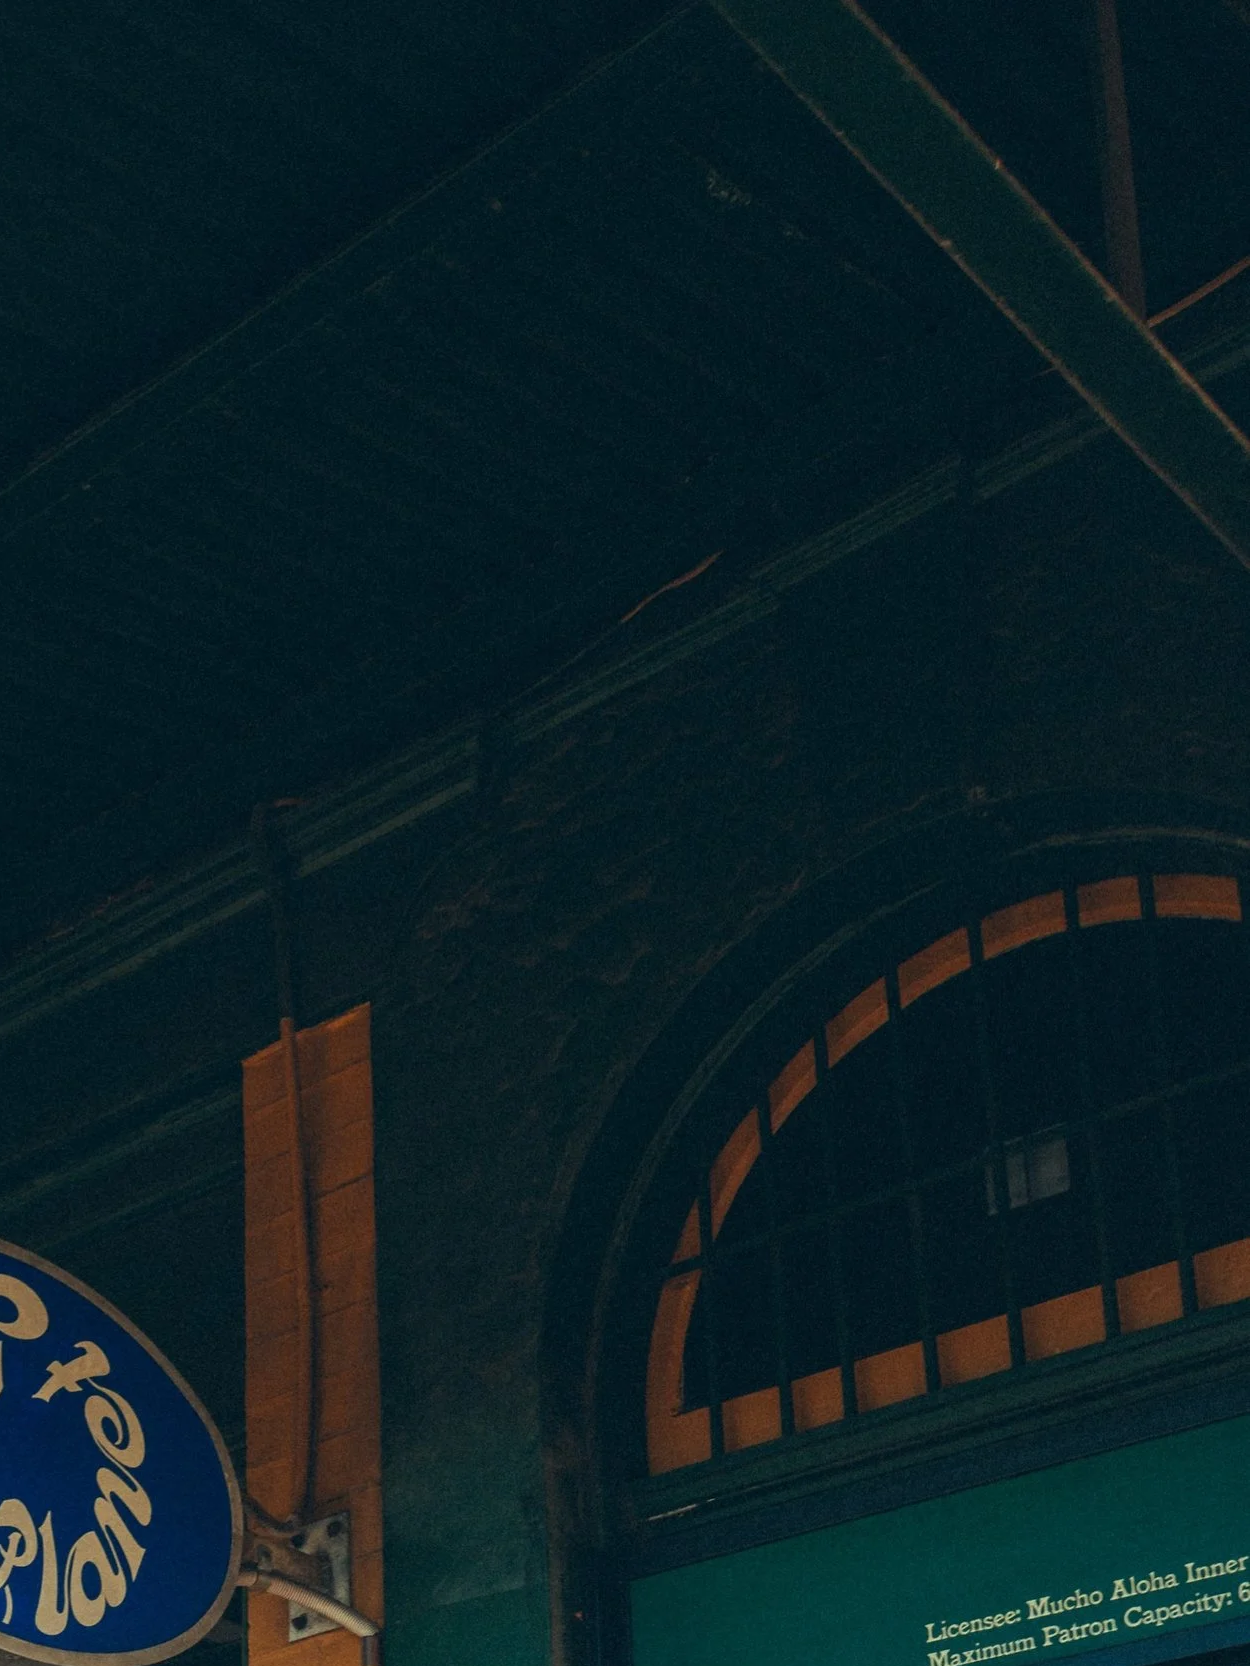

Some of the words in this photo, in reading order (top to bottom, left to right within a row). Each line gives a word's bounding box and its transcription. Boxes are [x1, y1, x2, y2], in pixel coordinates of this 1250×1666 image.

[925, 1609, 1022, 1643] Licensee:
[1026, 1589, 1103, 1620] Mucho
[1110, 1571, 1180, 1601] Aloha
[1184, 1555, 1249, 1583] Inner
[1042, 1618, 1118, 1647] Patron
[1124, 1592, 1233, 1627] Capacity:
